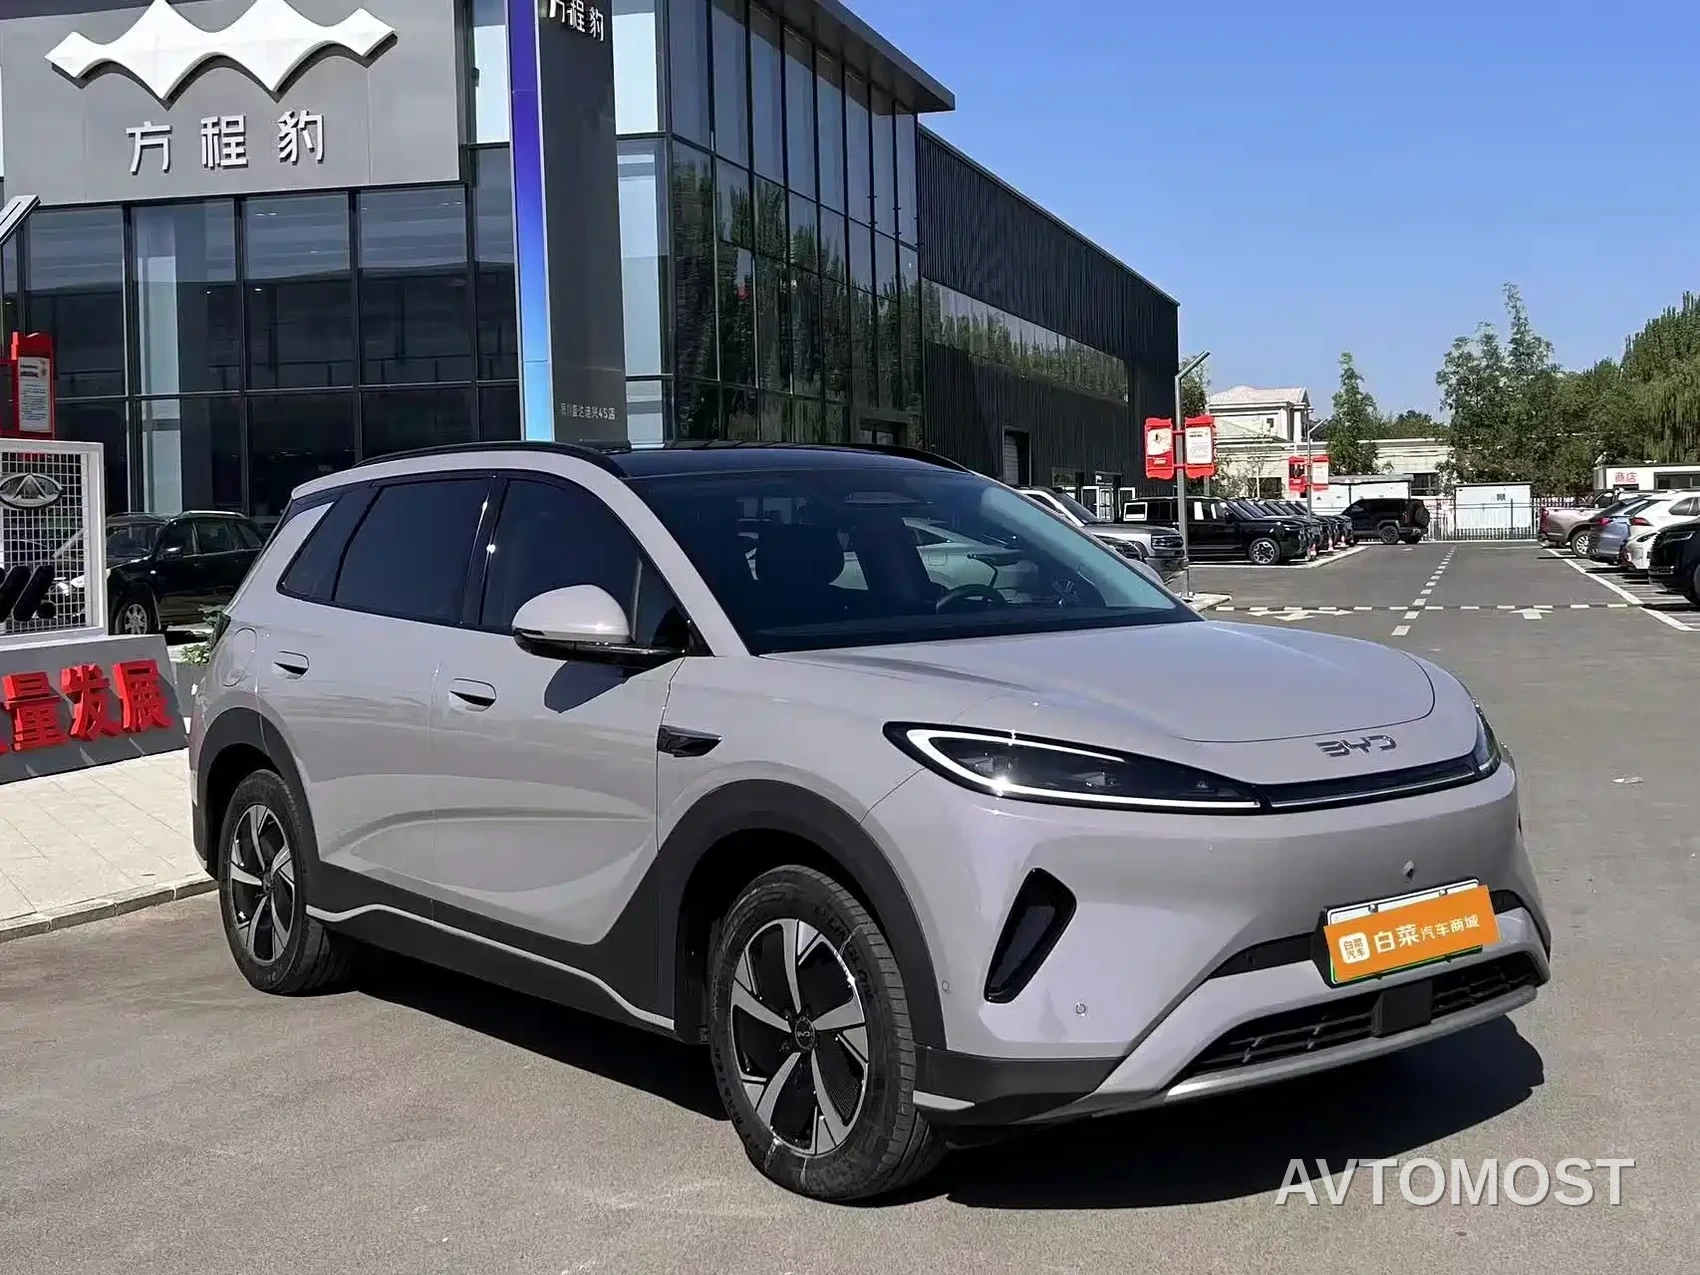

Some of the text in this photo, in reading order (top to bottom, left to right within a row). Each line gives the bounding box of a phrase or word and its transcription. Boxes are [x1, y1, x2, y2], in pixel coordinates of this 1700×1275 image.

[126, 110, 324, 174] 方程豹
[1614, 471, 1638, 483] 商店
[0, 656, 173, 755] 量发展
[1315, 735, 1396, 757] BYD
